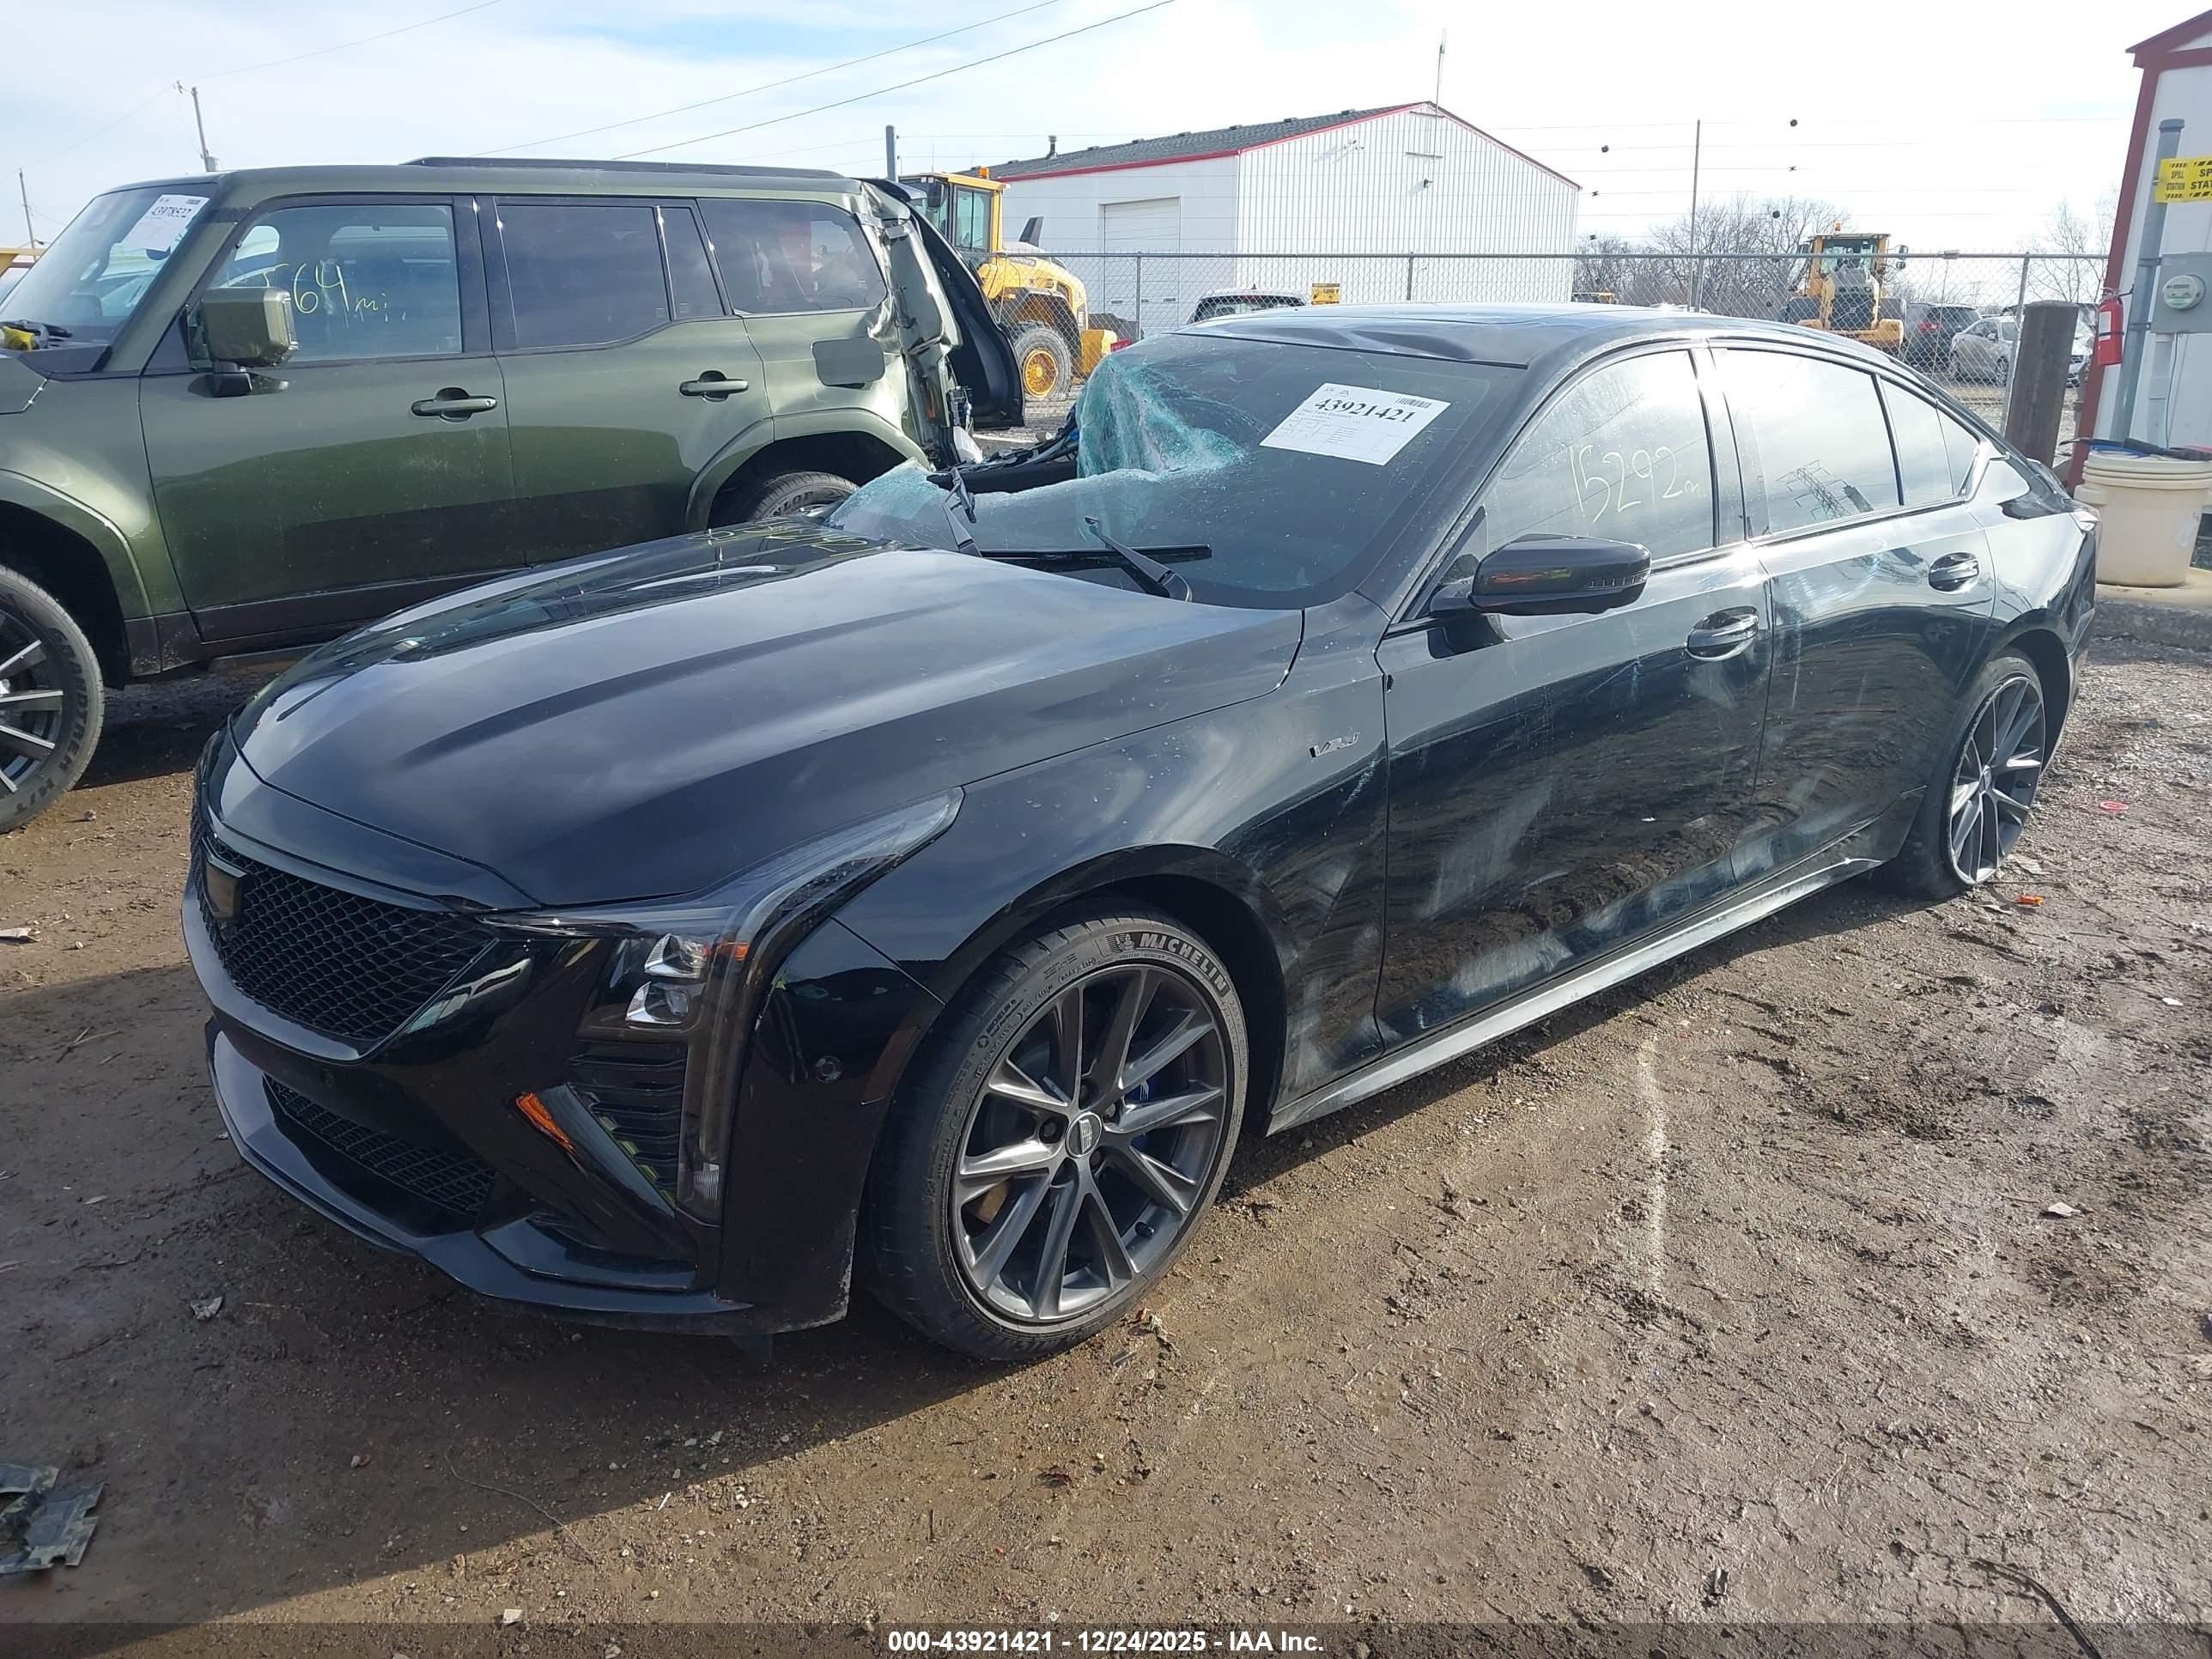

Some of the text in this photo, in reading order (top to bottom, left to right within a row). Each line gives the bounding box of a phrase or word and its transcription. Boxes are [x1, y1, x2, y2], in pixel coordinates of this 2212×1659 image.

[1315, 398, 1416, 423] 43921421
[1567, 443, 1683, 525] 15292
[1139, 933, 1230, 993] MICHELIN
